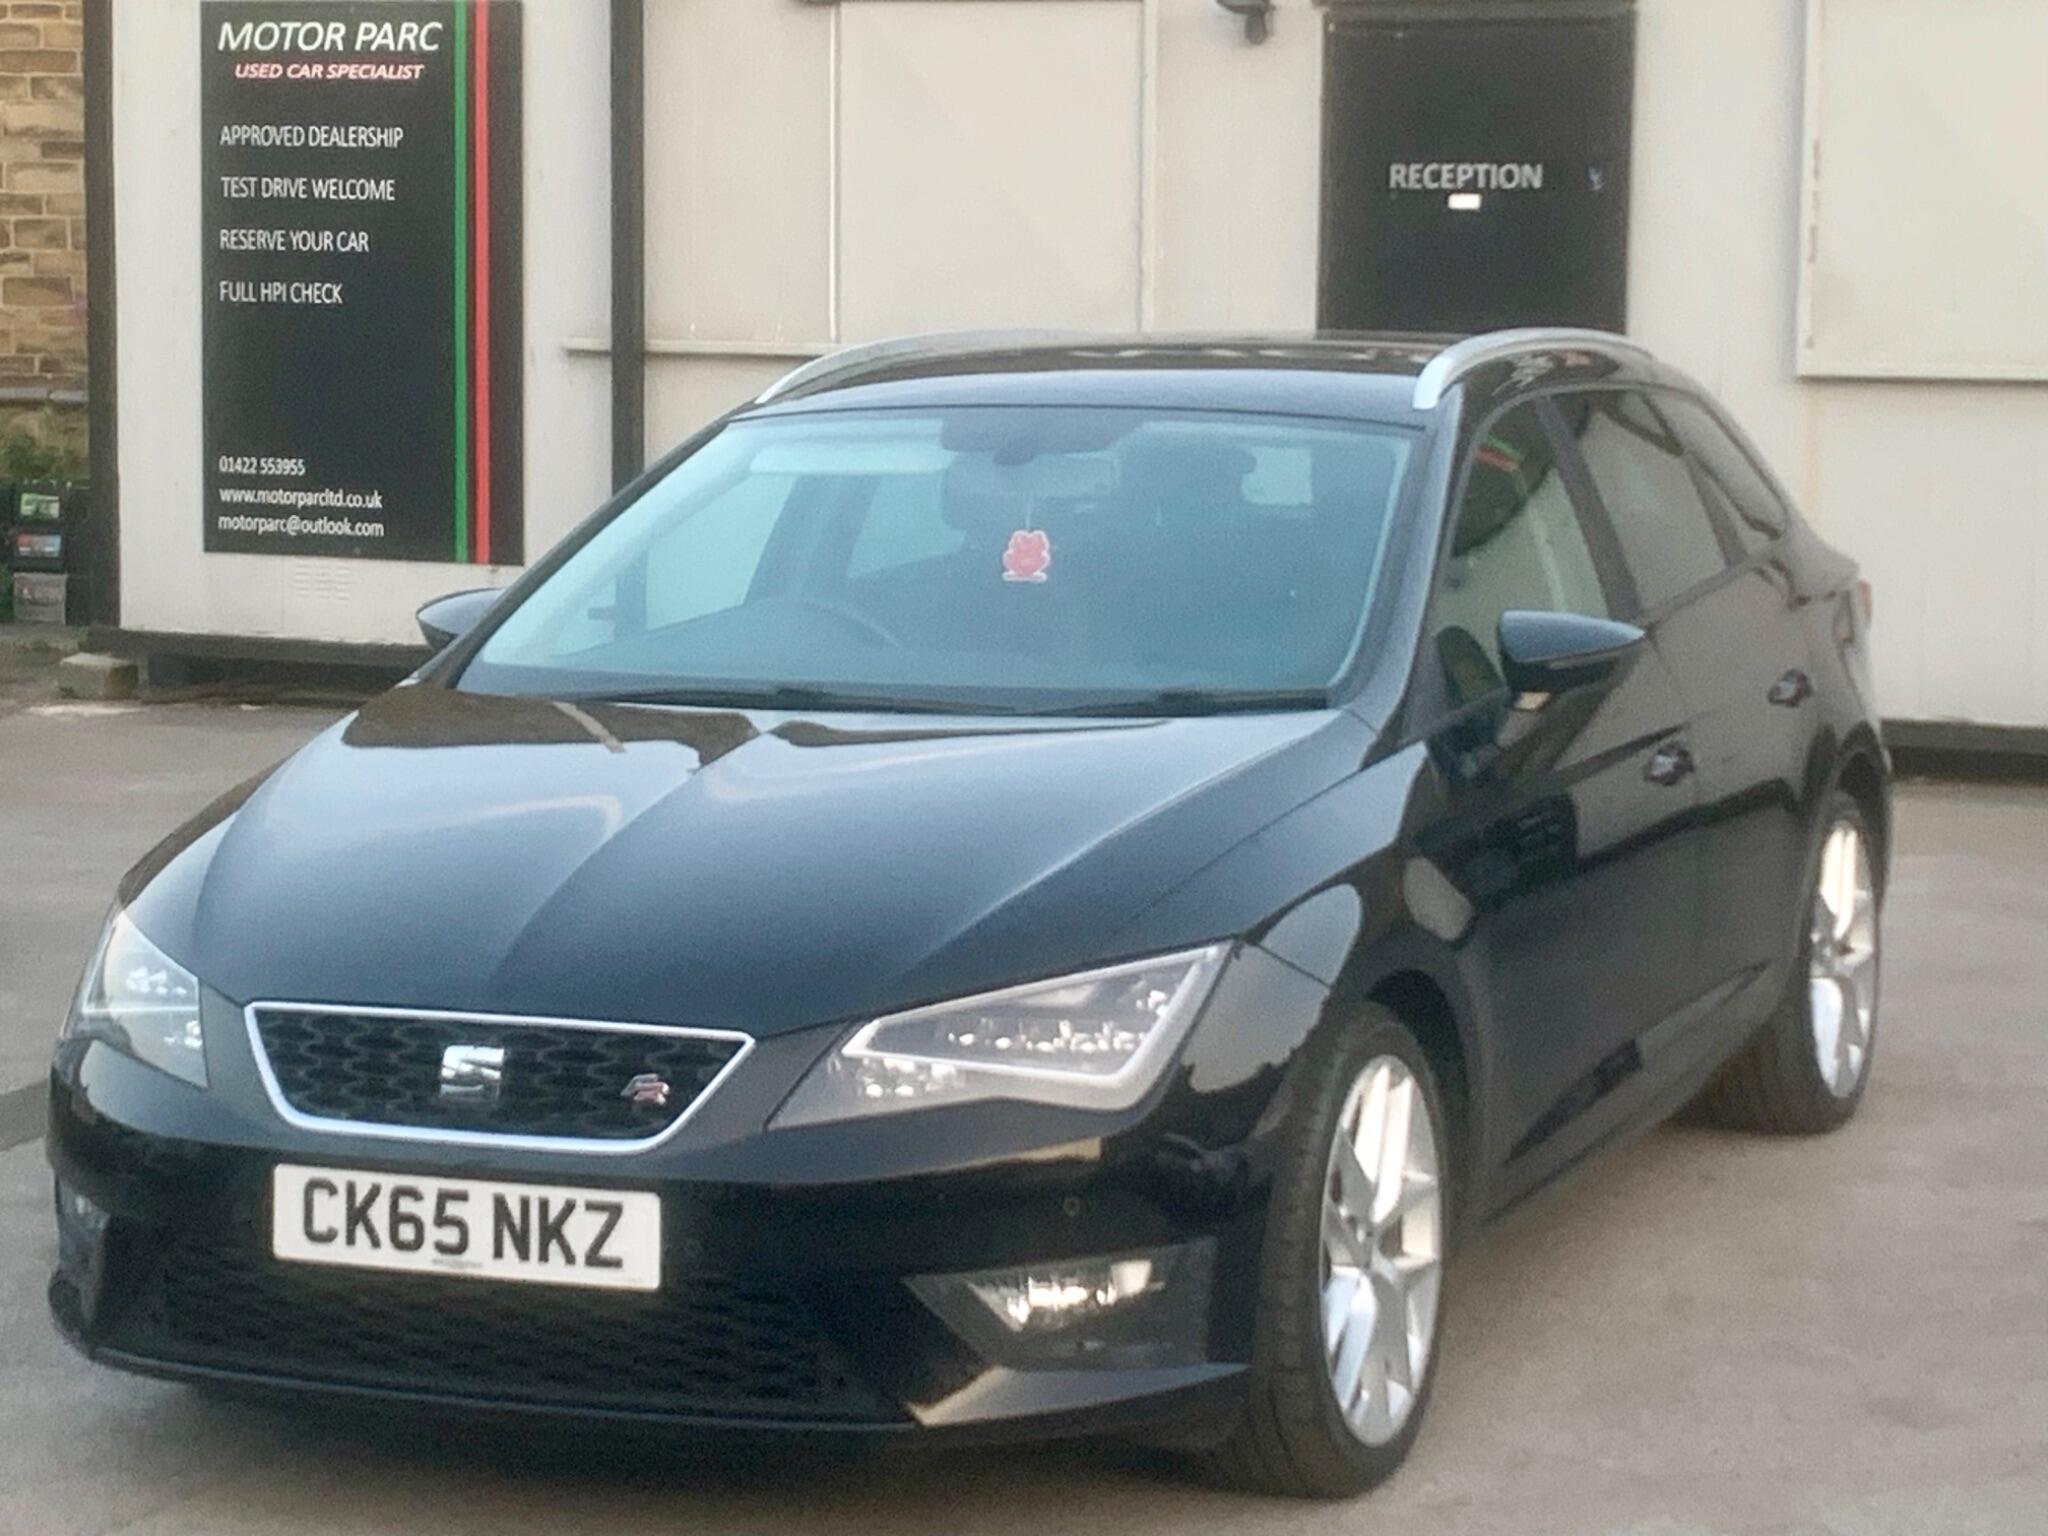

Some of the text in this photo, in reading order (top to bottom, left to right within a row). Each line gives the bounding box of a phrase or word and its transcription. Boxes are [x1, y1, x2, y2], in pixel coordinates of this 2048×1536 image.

[217, 21, 443, 51] MOTOR PARC
[235, 63, 425, 80] USED CAR SPECIALIST
[219, 125, 404, 148] APPROVED DEALERSHIP
[1389, 163, 1544, 190] RECEPTION
[221, 177, 396, 201] TEST DRIVE WELCOME
[219, 229, 370, 252] RESERVE YOUR CAR
[219, 281, 343, 304] FULL HPI CHECK
[218, 455, 306, 476] 01422 553955
[219, 488, 382, 508] www.motorparcltd.co.uk
[218, 515, 384, 536] motorparc@outlook.com
[302, 1177, 624, 1269] CK65 NKZ
